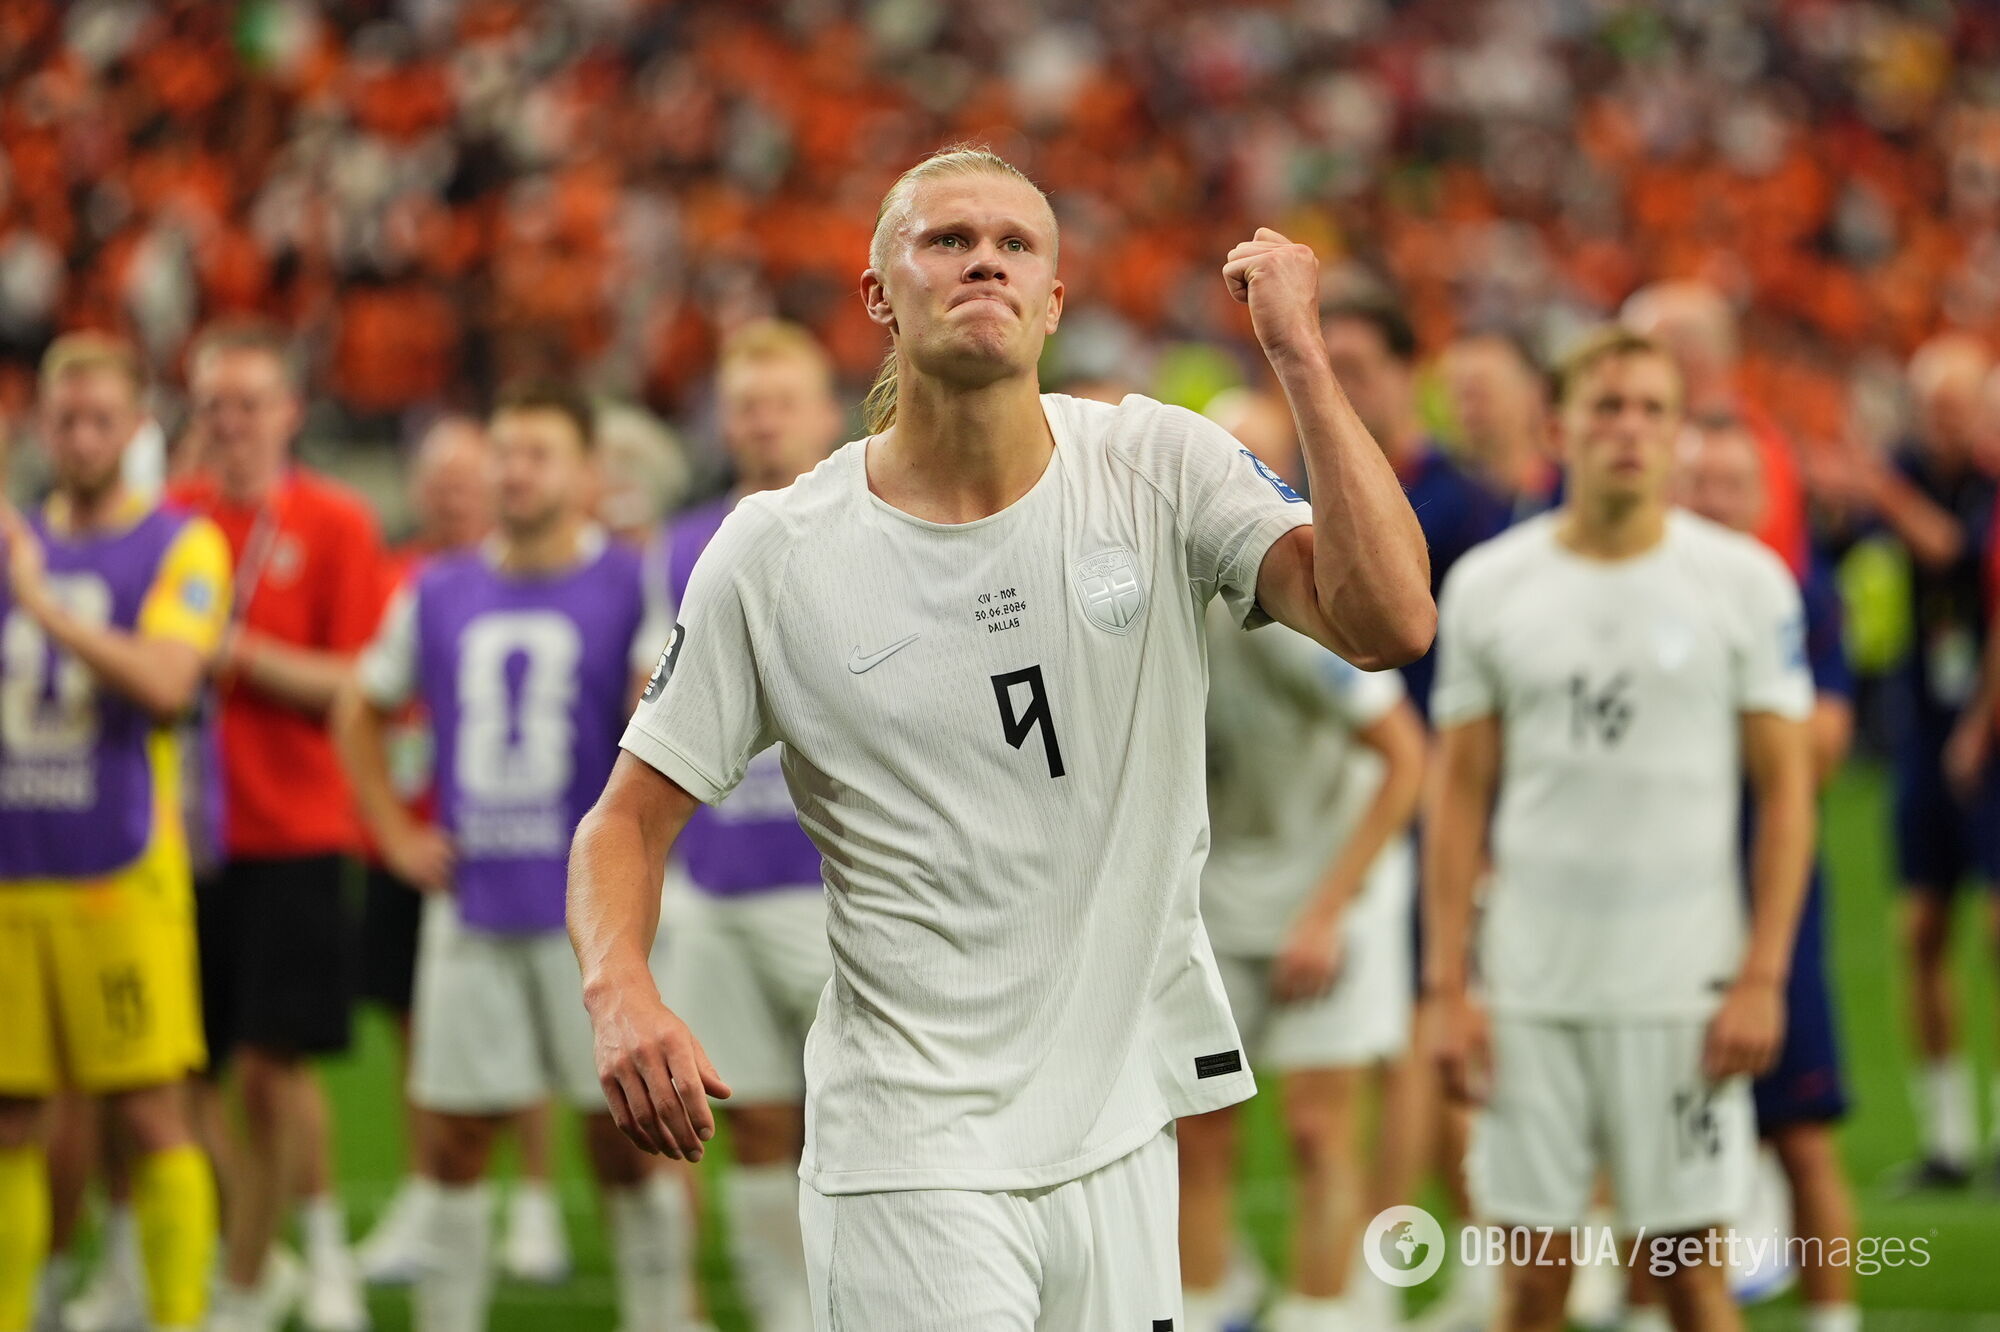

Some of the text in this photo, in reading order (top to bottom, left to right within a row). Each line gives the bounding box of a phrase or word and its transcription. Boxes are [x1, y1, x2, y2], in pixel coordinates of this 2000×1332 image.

[977, 593, 991, 605] CIV
[975, 601, 1026, 621] 30.06.2026
[988, 617, 1020, 634] DALLAS
[991, 664, 1065, 778] 9
